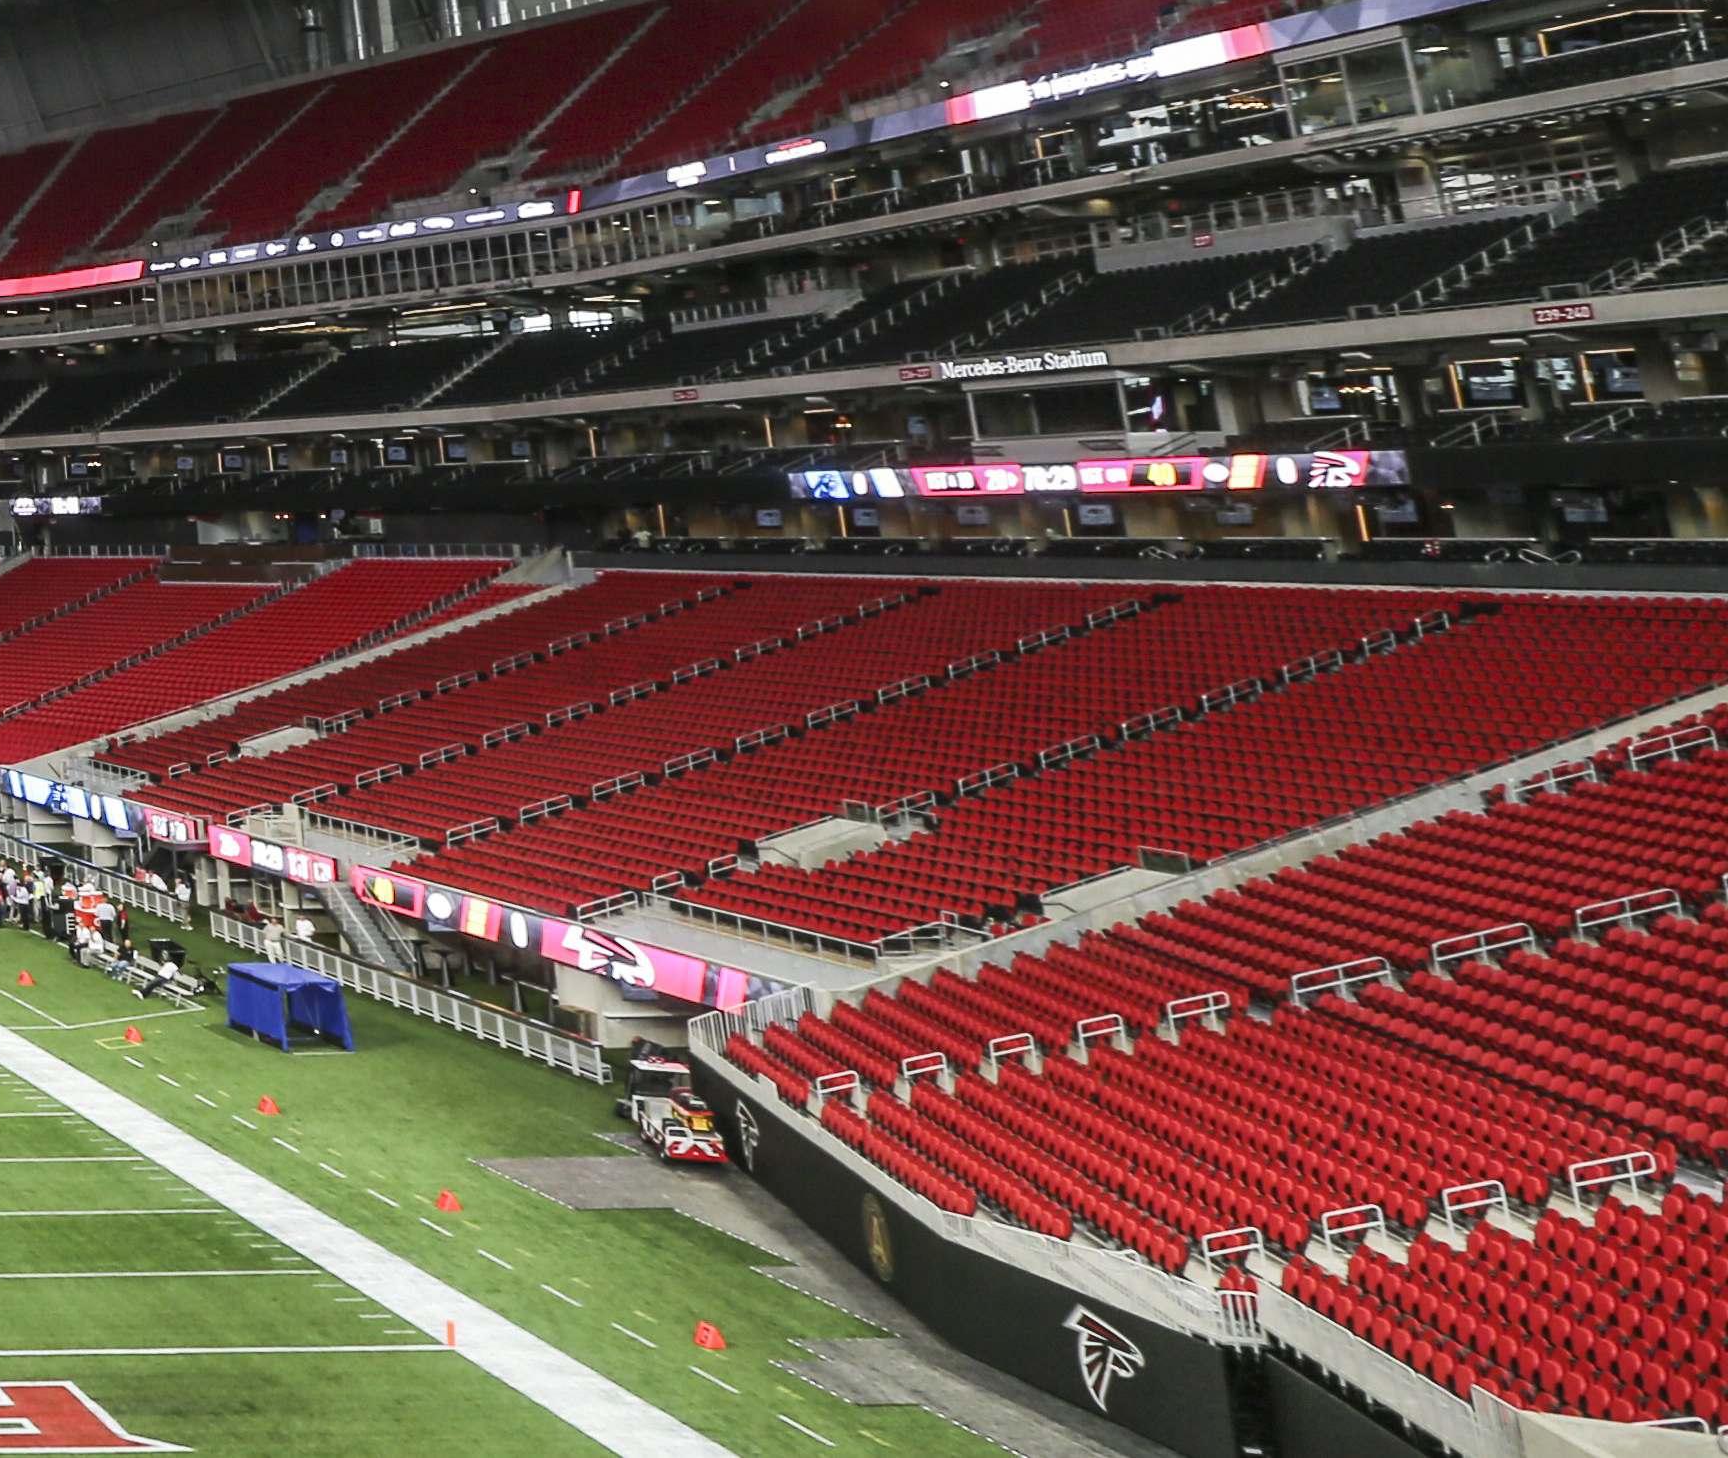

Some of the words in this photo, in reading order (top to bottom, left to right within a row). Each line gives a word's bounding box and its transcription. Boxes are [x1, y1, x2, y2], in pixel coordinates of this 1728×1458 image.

[940, 355, 1042, 379] Mercedes-Benz
[1044, 350, 1109, 370] Stadium
[1022, 464, 1077, 491] 78:29
